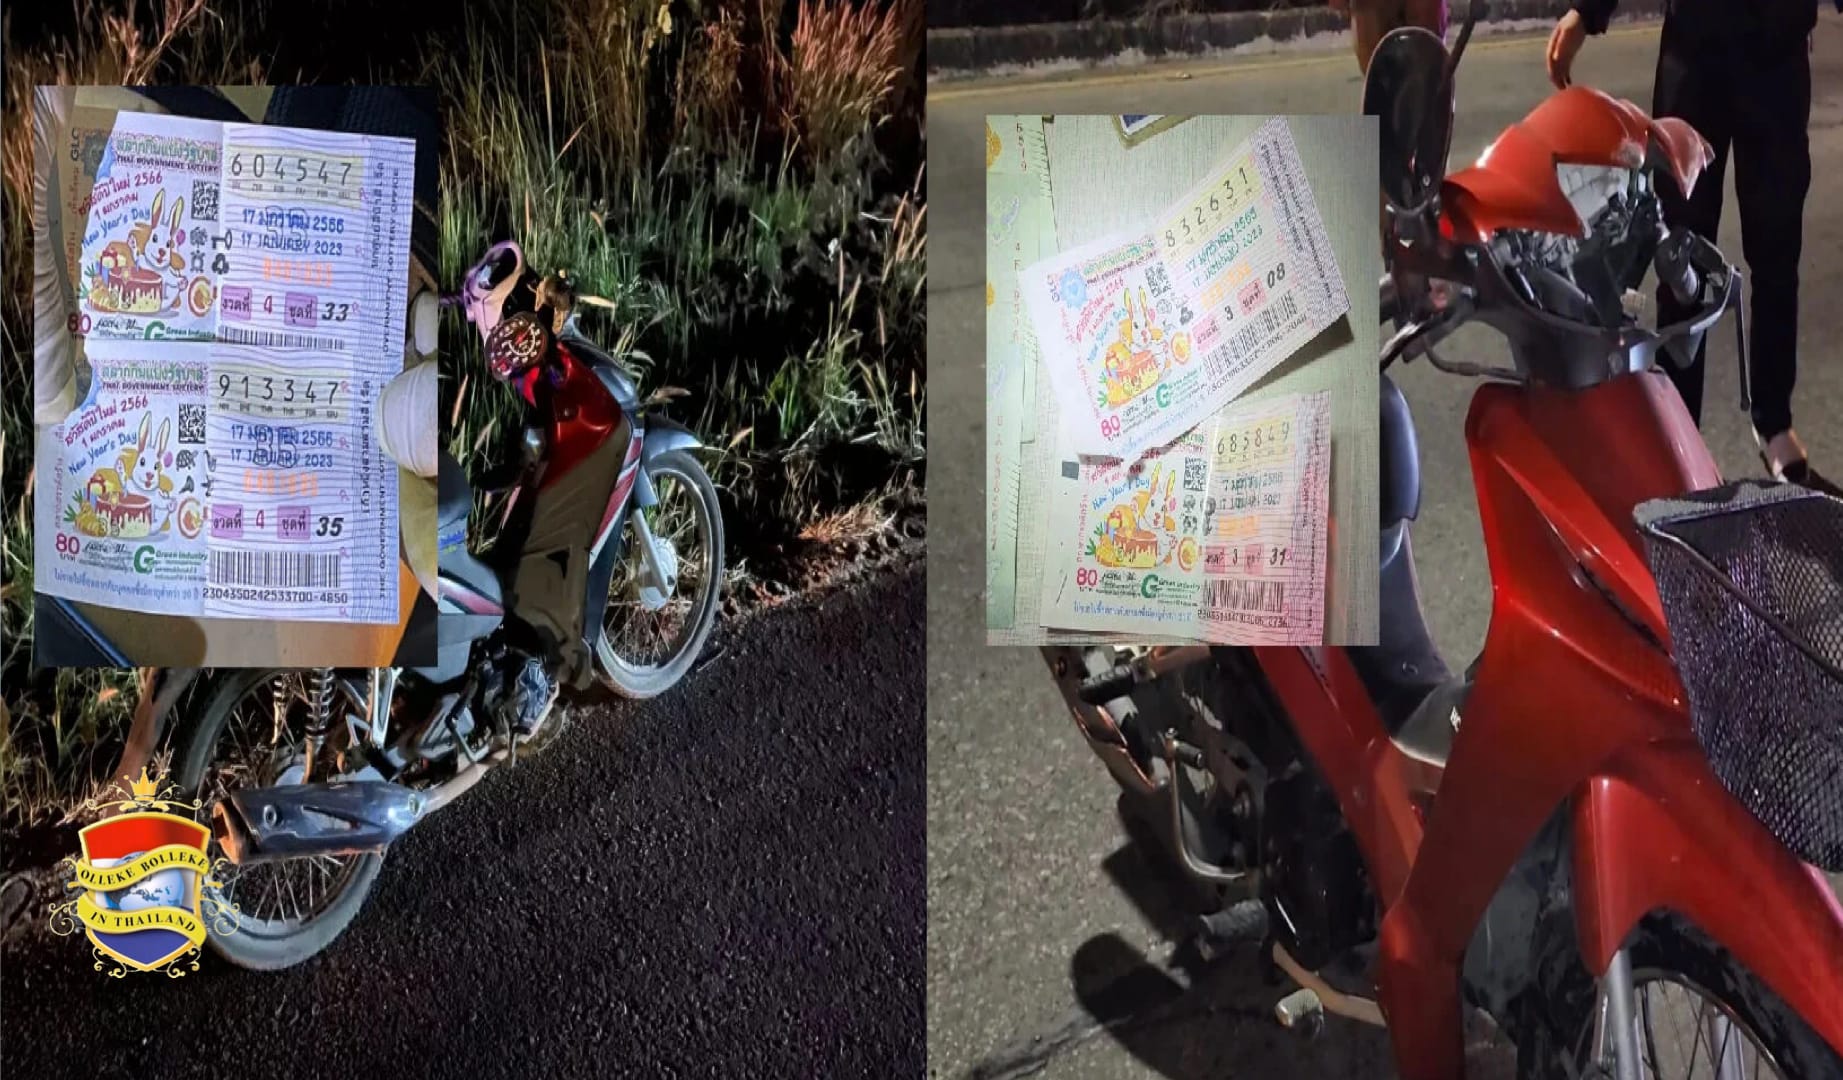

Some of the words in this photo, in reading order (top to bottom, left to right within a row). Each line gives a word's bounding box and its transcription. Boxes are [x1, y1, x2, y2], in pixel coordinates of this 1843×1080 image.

[135, 170, 163, 188] 2566
[1165, 167, 1249, 248] 832631
[81, 231, 99, 248] New
[130, 206, 150, 222] Day
[242, 208, 255, 224] 17
[313, 216, 345, 234] 2566
[314, 239, 343, 257] 2023
[1224, 305, 1234, 321] 3
[1267, 262, 1286, 289] 08
[222, 292, 250, 312] งวดที่
[288, 299, 313, 325] ชุดที่
[321, 302, 350, 322] 33
[67, 312, 92, 335] 80
[121, 395, 149, 413] 2566
[231, 424, 244, 440] 17
[302, 430, 333, 448] 2566
[1101, 415, 1121, 438] 80
[68, 457, 87, 476] New
[88, 440, 115, 465] Year's
[117, 430, 138, 445] Day
[82, 437, 88, 449] 1
[231, 449, 241, 462] 17
[304, 453, 333, 468] 2023
[1135, 476, 1150, 489] Day
[213, 509, 242, 530] งวดที่
[255, 509, 265, 530] 4
[282, 509, 307, 536] ชุดที่
[315, 516, 345, 537] 35
[55, 533, 81, 555] 80
[156, 551, 177, 560] Green
[178, 550, 209, 561] Industry
[1076, 567, 1098, 588] 80
